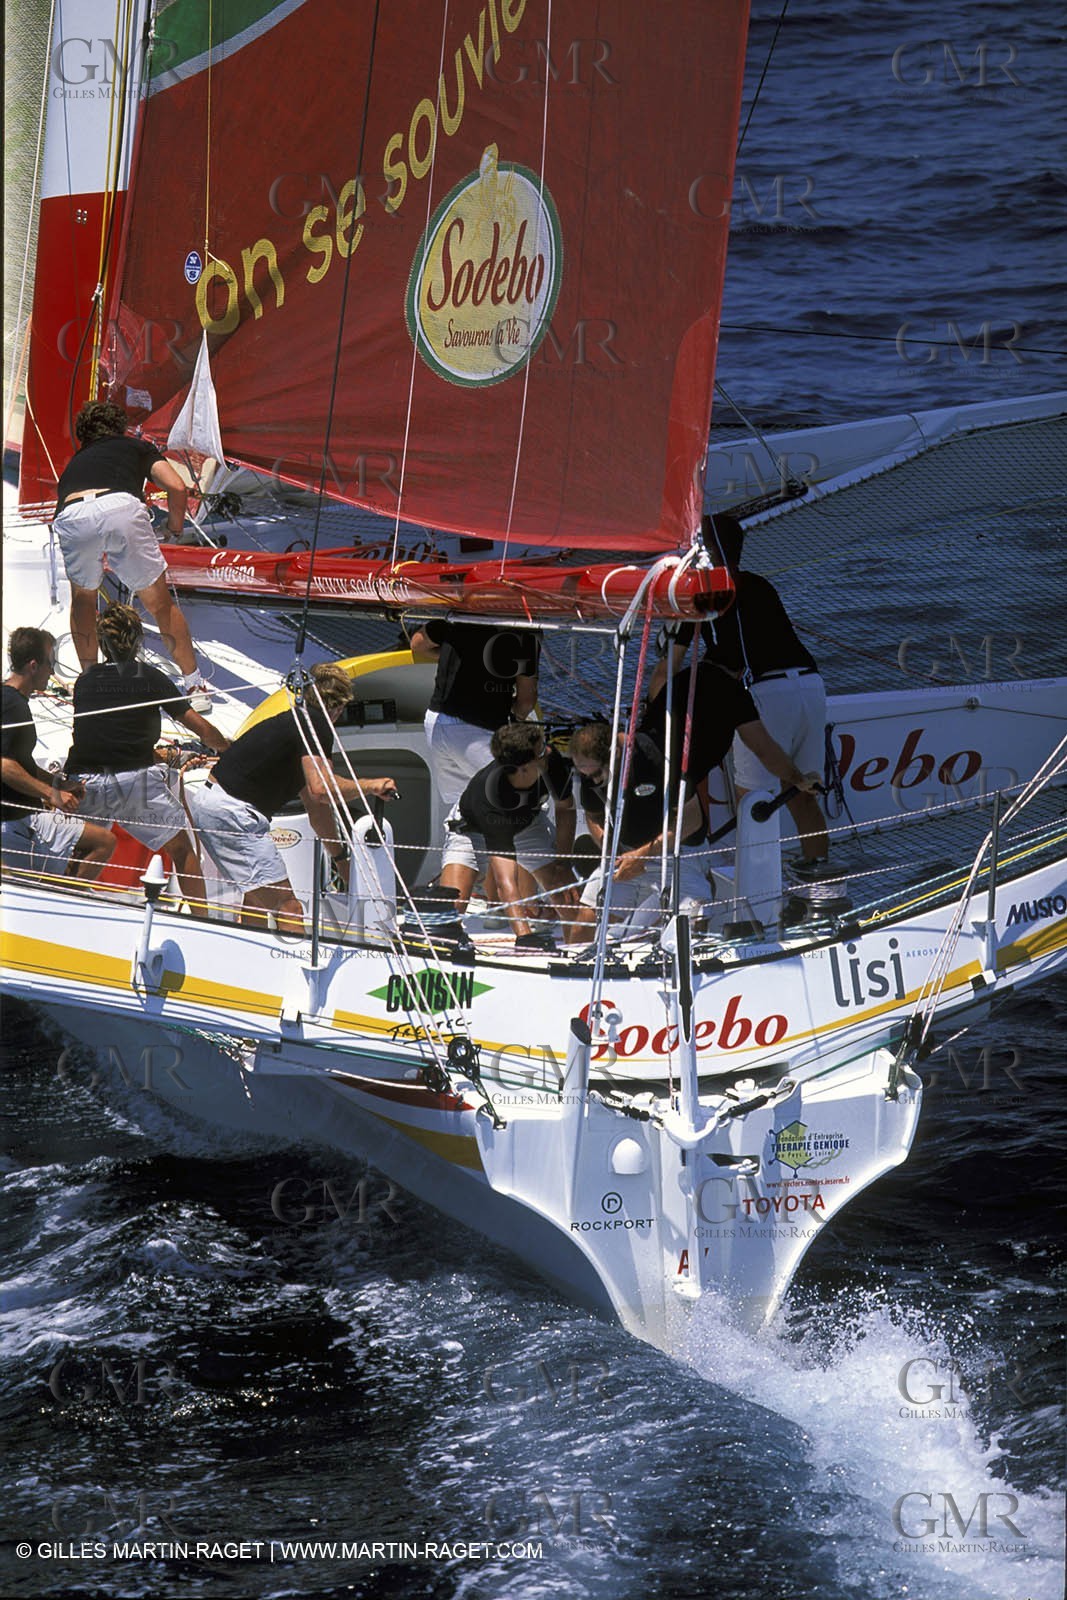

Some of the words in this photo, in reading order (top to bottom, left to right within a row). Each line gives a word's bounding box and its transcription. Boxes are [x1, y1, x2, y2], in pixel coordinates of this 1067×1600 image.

[196, 239, 284, 334] on
[303, 180, 366, 283] se
[427, 217, 544, 311] Sodebo
[445, 318, 493, 348] Savourons
[507, 316, 521, 344] Vie
[1006, 894, 1067, 926] MUSTO
[386, 971, 474, 1012] COUSIN
[771, 1142, 811, 1153] THERAPIE
[814, 1139, 850, 1151] GENIQUE
[742, 1194, 825, 1215] TOYOTA
[570, 1218, 654, 1231] ROCKPORT
